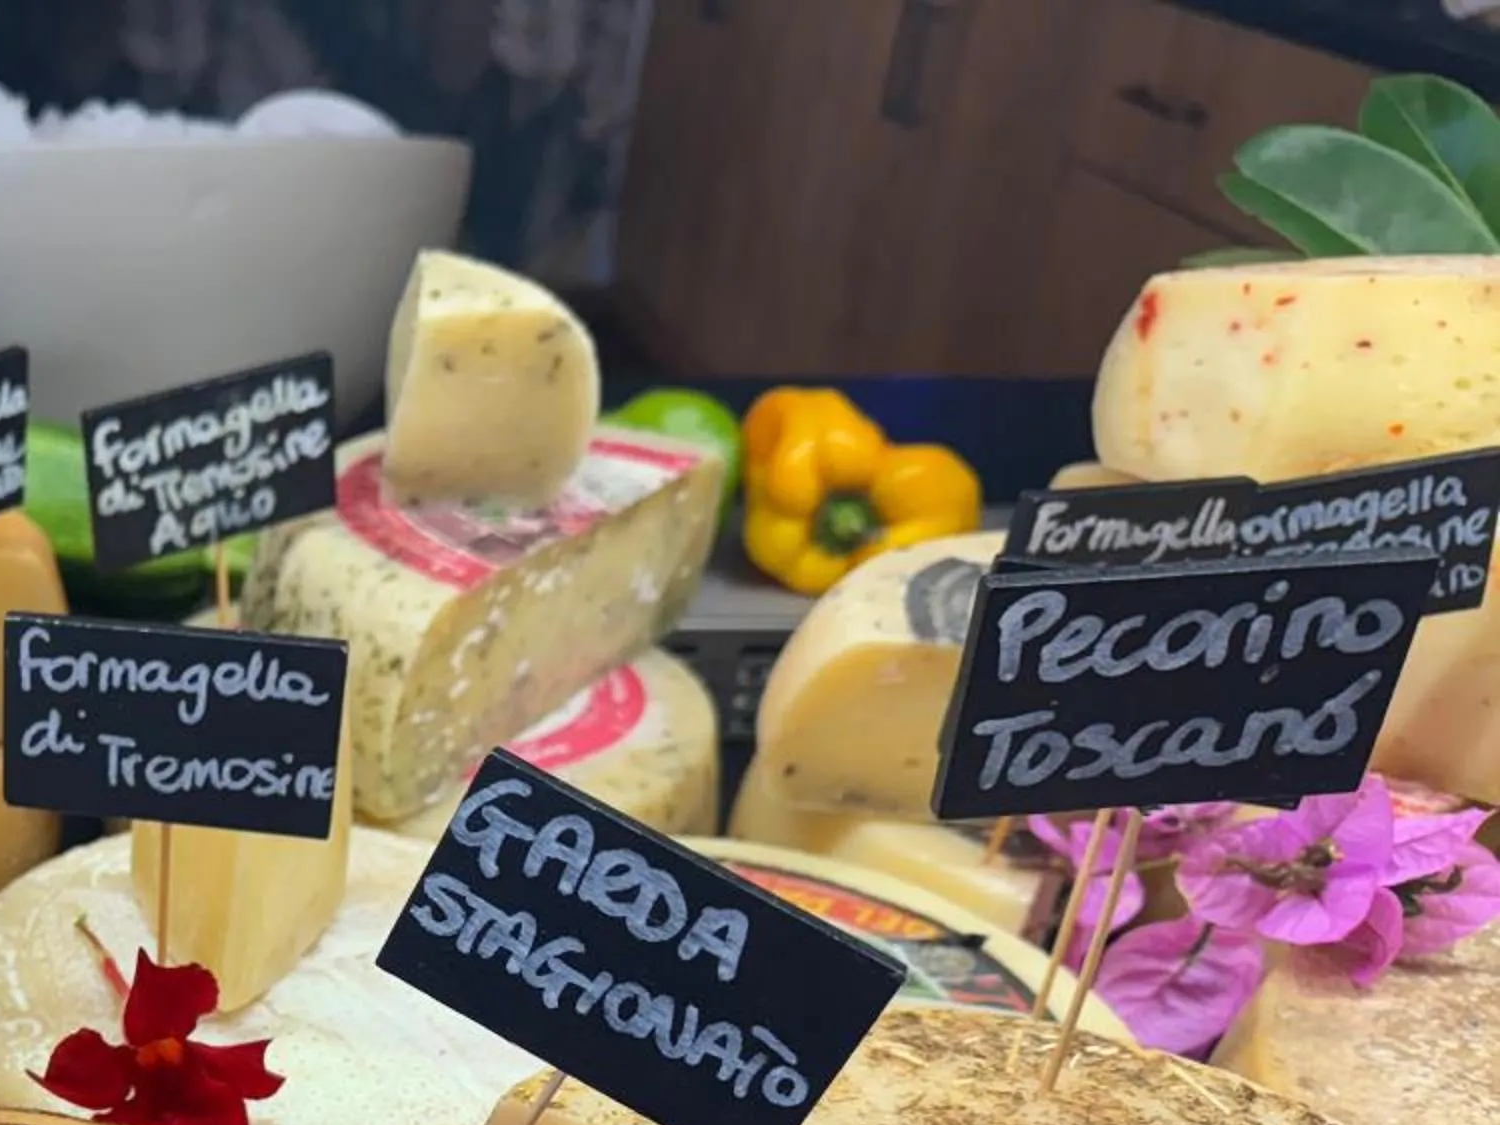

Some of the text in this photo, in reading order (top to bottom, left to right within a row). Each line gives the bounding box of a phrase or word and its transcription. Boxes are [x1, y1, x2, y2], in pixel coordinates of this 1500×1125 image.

[98, 419, 332, 517] di Tremosine
[1239, 474, 1467, 546] ormagella
[150, 486, 276, 555] Aglio
[1026, 498, 1236, 564] Formagella
[998, 579, 1404, 683] Pecorino
[20, 708, 334, 799] di Tremosine
[449, 778, 749, 982] GARDA
[408, 872, 810, 1108] STAGIONATO
